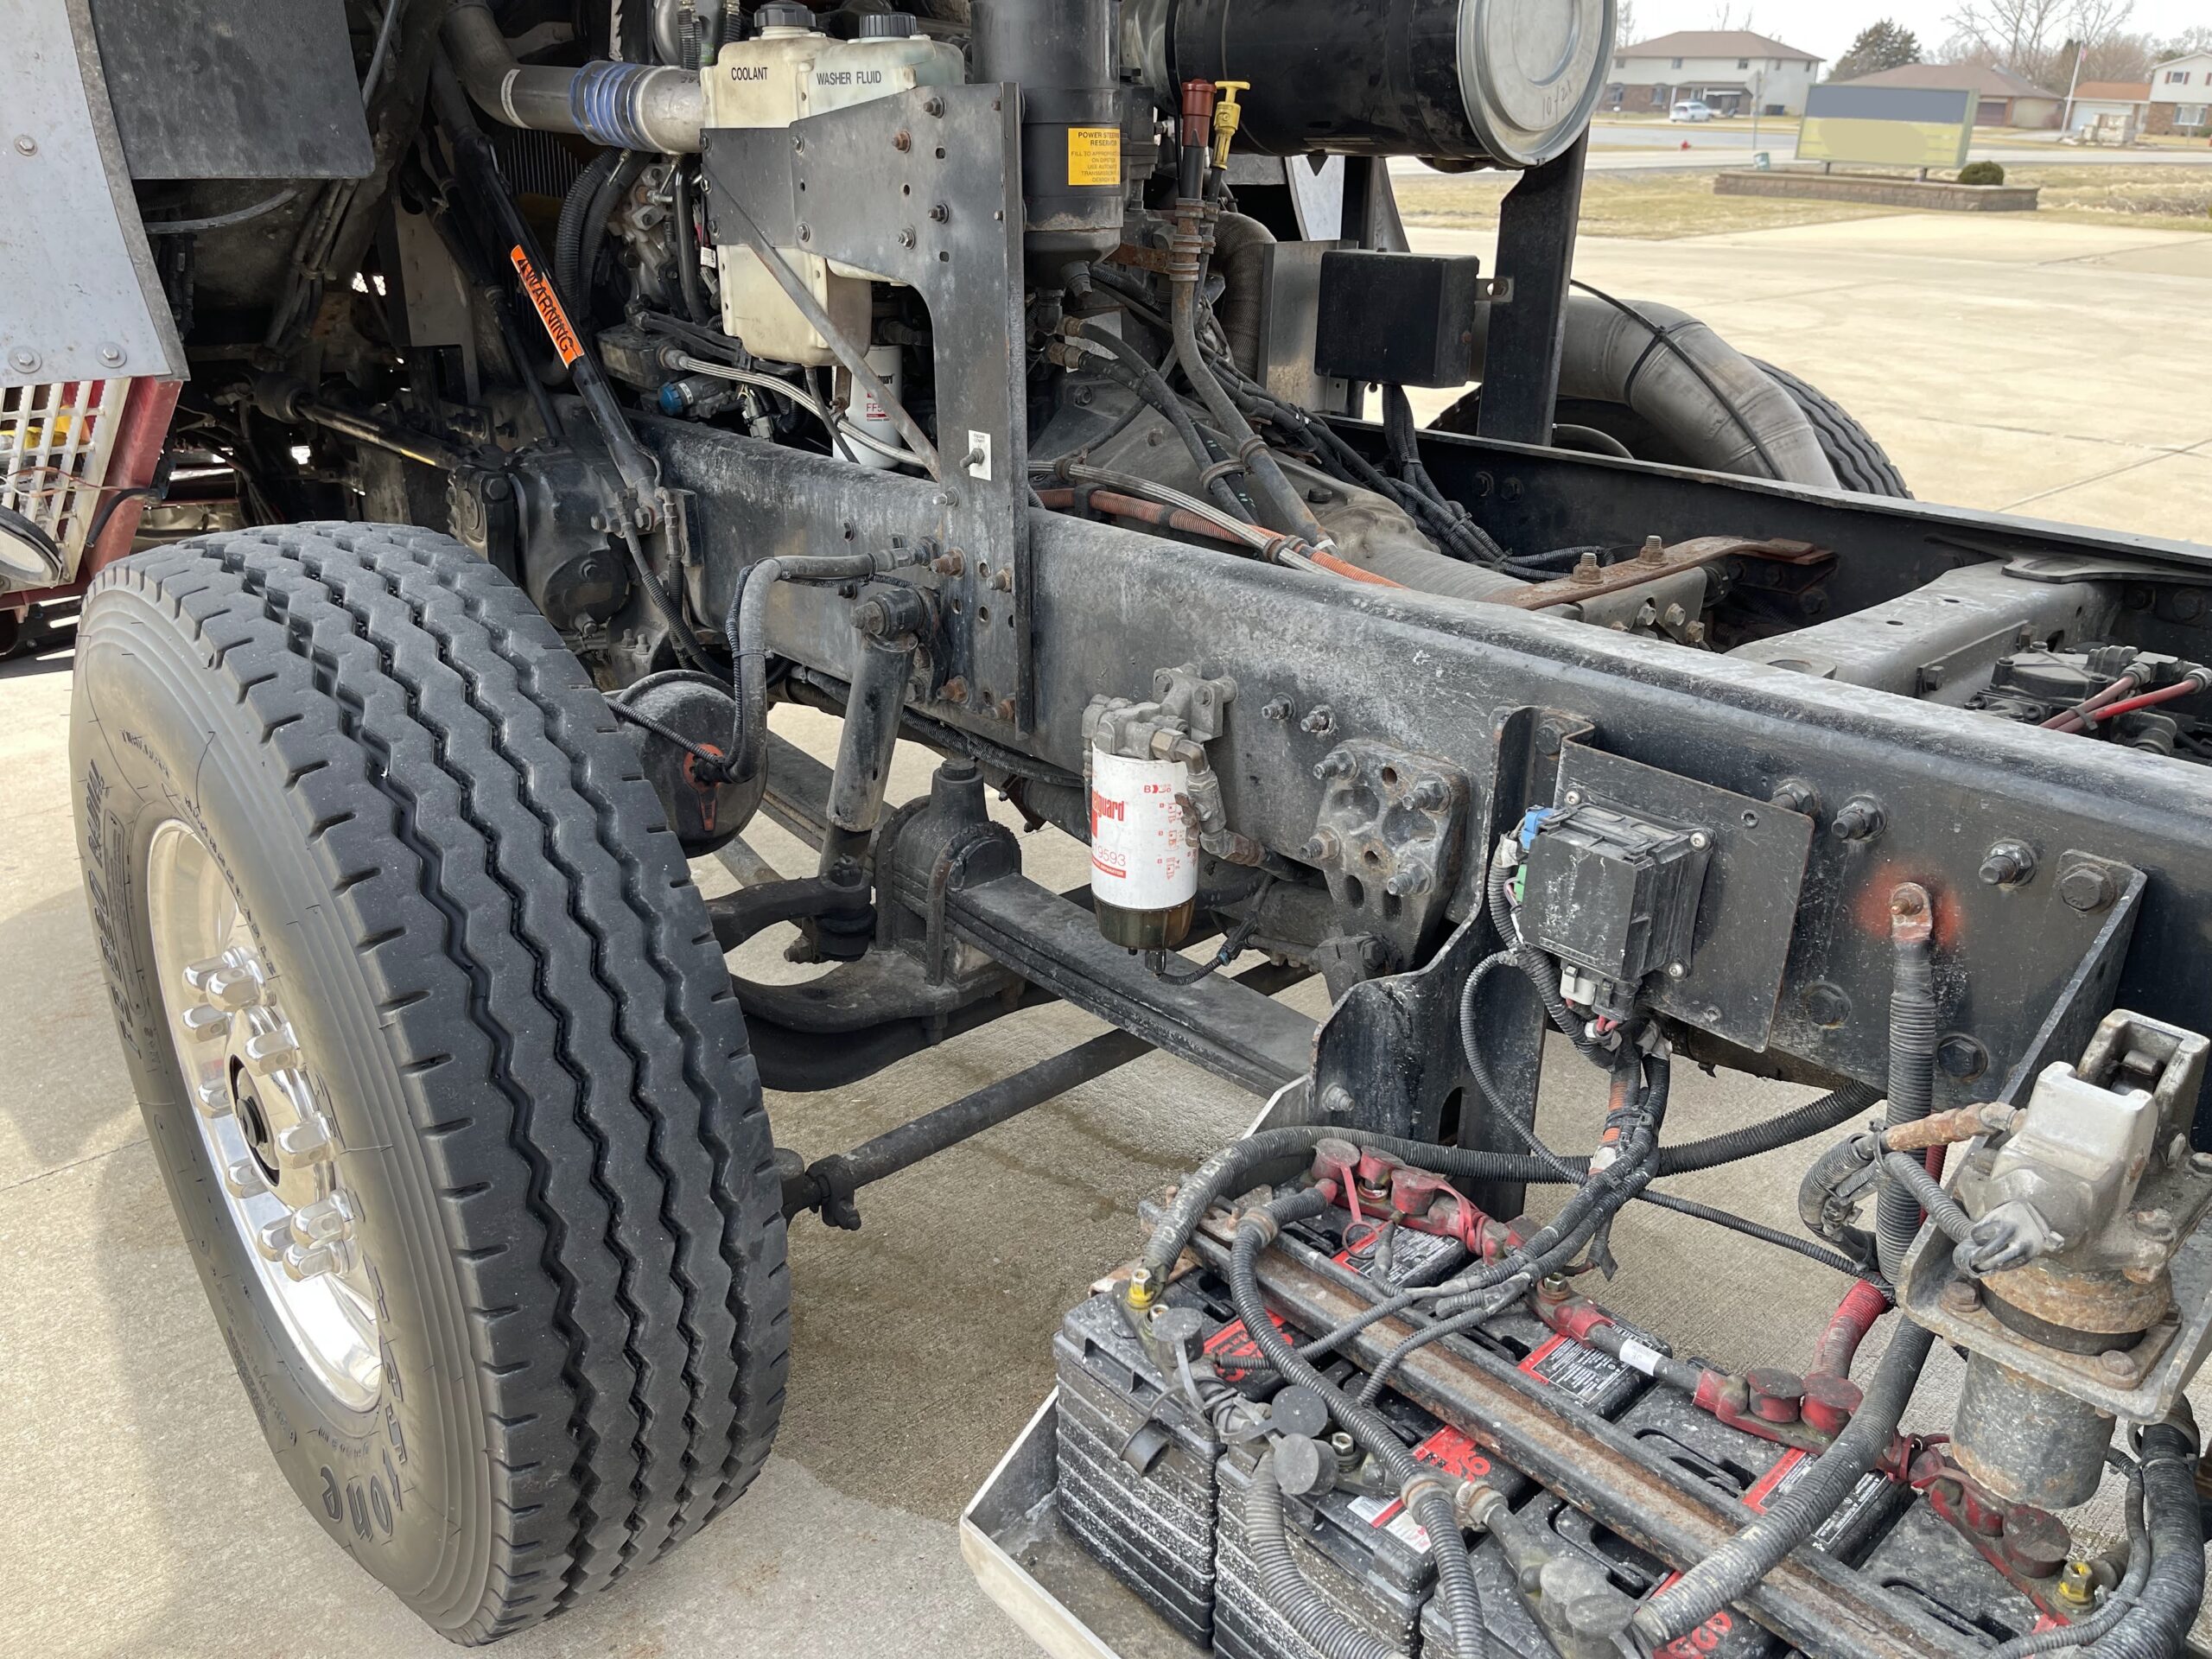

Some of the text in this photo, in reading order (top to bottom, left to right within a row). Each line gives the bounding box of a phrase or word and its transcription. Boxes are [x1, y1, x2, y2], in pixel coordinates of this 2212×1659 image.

[731, 67, 768, 81] COOLANT
[817, 70, 882, 86] WASHER FLUID
[525, 269, 575, 353] WARNING
